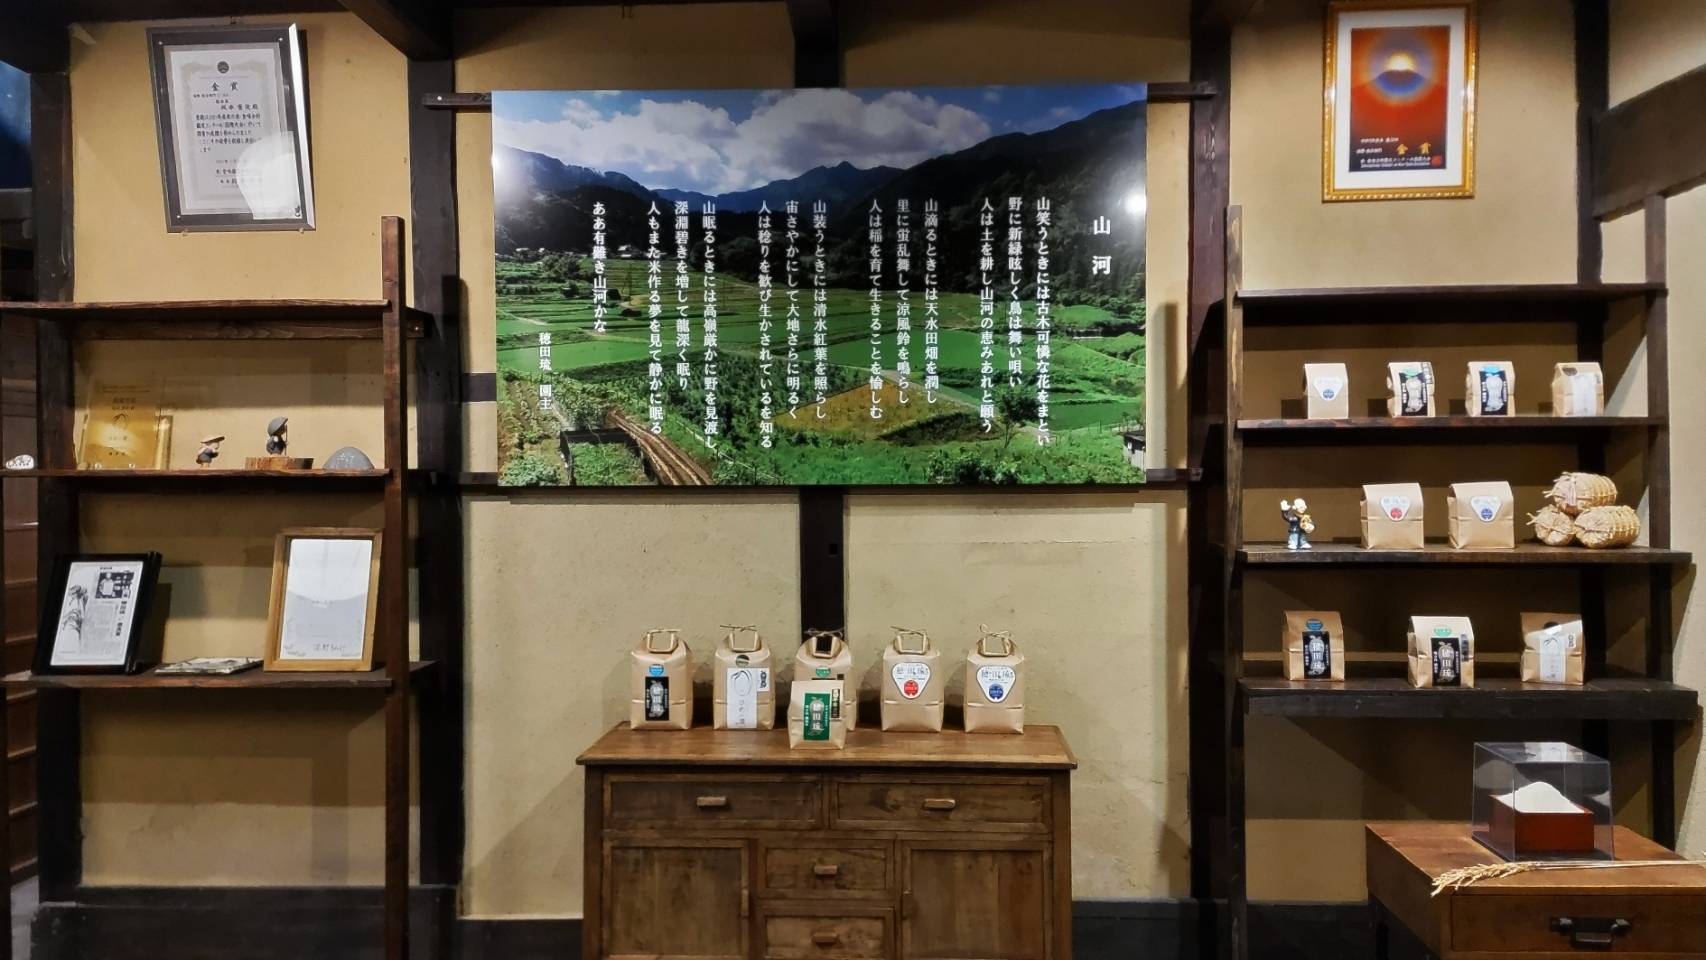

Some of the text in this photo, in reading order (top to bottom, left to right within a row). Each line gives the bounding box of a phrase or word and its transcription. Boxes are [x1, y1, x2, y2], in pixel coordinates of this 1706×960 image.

[592, 201, 607, 333] ああ有難き山河かな
[647, 201, 663, 434] 人もまた米作る夢を見て静かに眠る
[702, 201, 718, 449] 山眠るときには高嶺厳かに野を見渡し
[758, 200, 773, 448] 人は稔りを歓び生かされているを知る
[785, 200, 800, 420] 宙さやかにして大地さらに明るく
[813, 199, 828, 419] 山装うときには清水紅葉を照らし
[869, 199, 883, 419] 人は稲を育て生きることを愉しむ
[896, 199, 911, 404] 里に蛍乱舞して涼風鈴を鳴らし
[924, 198, 939, 404] 山滴るときには天水田畑を潤し
[979, 197, 995, 433] 人は土を耕し山河の恵みあれと願う
[1008, 197, 1023, 388] 野に新緑眩しく鳥は舞い唄い
[1036, 196, 1051, 446] 山笑うときには古木可憐な花をまとい
